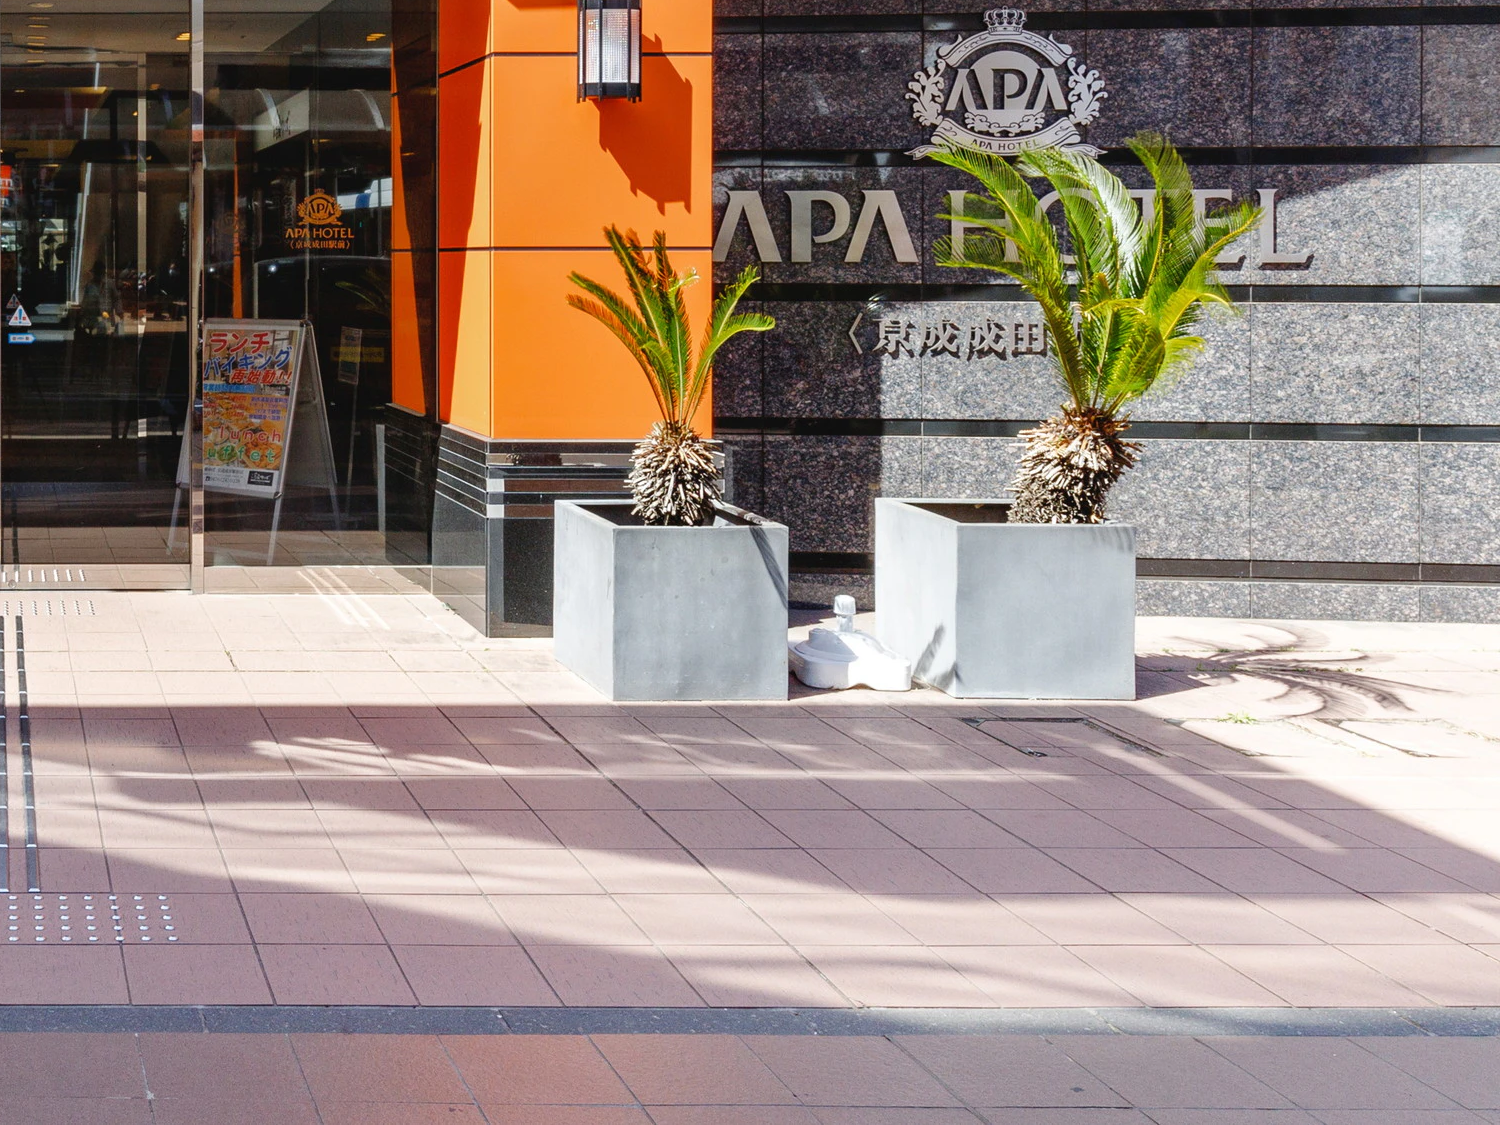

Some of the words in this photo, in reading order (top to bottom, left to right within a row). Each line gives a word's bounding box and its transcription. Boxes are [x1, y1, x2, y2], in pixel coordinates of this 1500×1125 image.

[945, 68, 1068, 111] APA
[971, 138, 993, 151] APA
[998, 138, 1041, 151] HOTEL
[307, 202, 335, 214] APA
[285, 228, 310, 238] APA
[313, 228, 355, 238] HOTEL
[713, 190, 919, 263] APA
[210, 332, 270, 354] ランチ
[204, 346, 293, 378] バイキング
